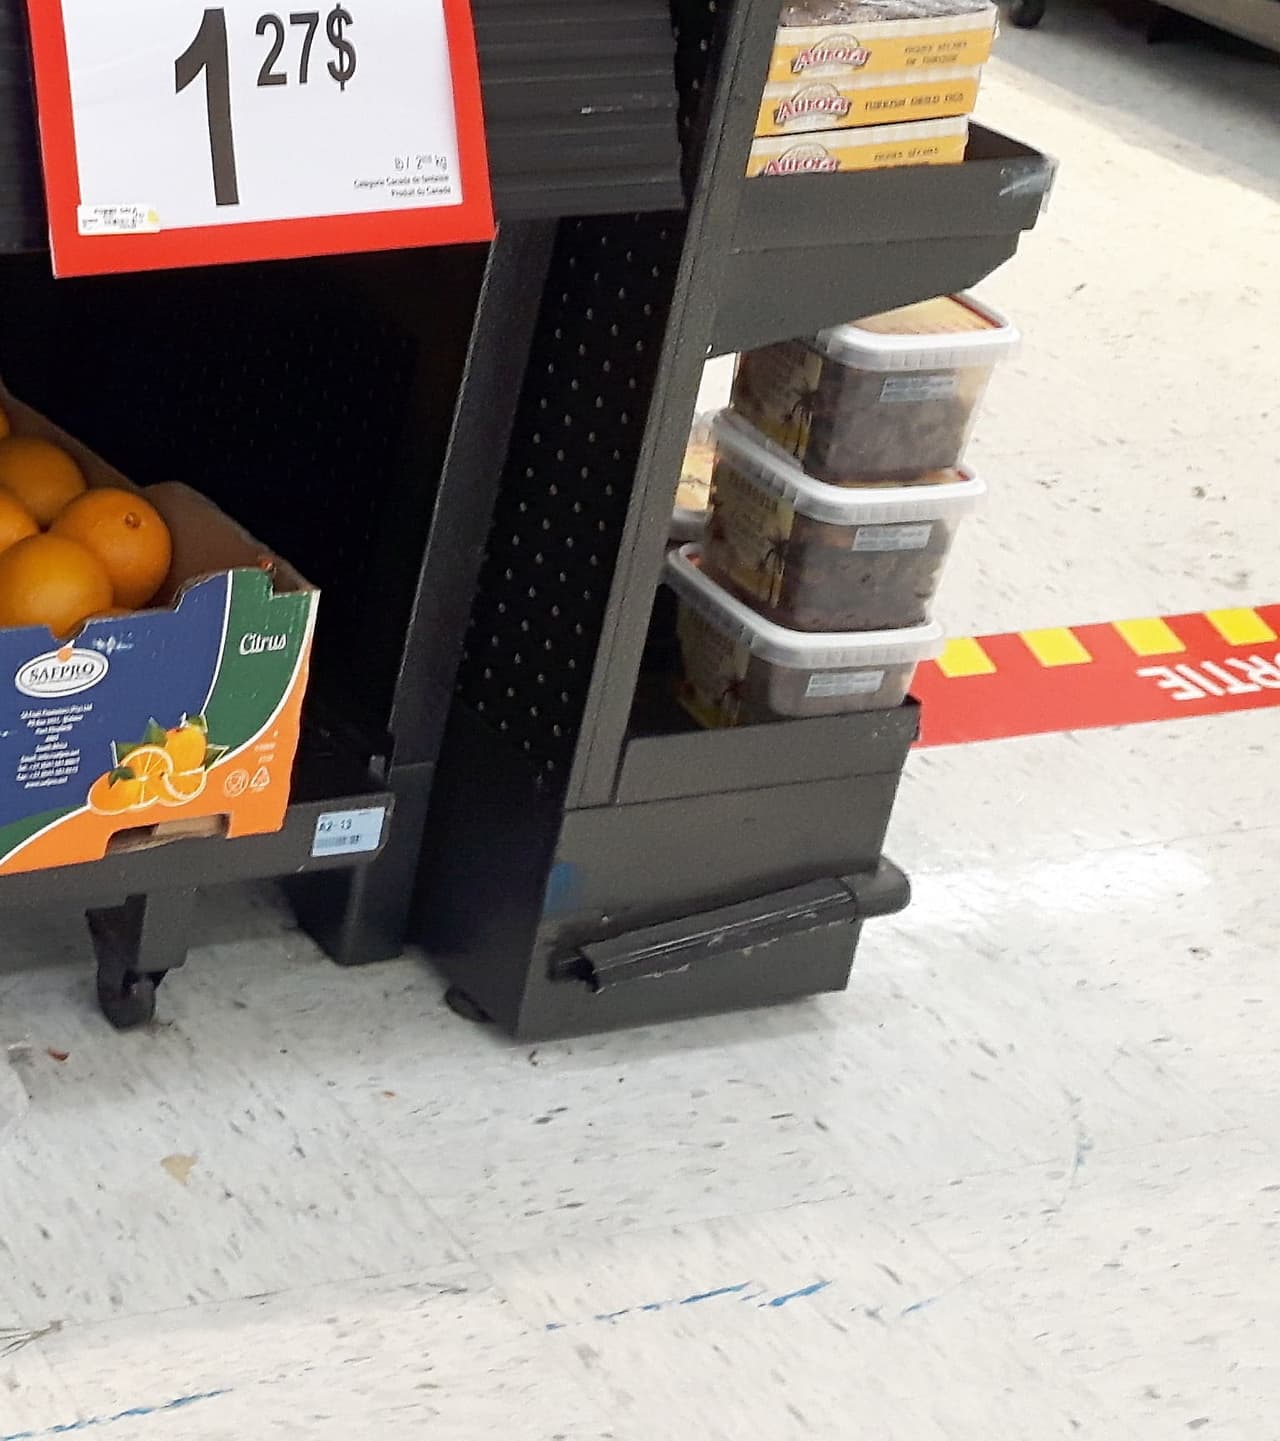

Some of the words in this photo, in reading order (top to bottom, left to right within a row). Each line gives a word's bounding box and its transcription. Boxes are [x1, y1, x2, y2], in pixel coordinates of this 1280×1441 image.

[791, 46, 872, 74] Aurora
[774, 95, 852, 125] Aurora
[239, 632, 288, 656] Citrus
[29, 663, 96, 683] SAFPRO
[1136, 652, 1280, 701] RTIE
